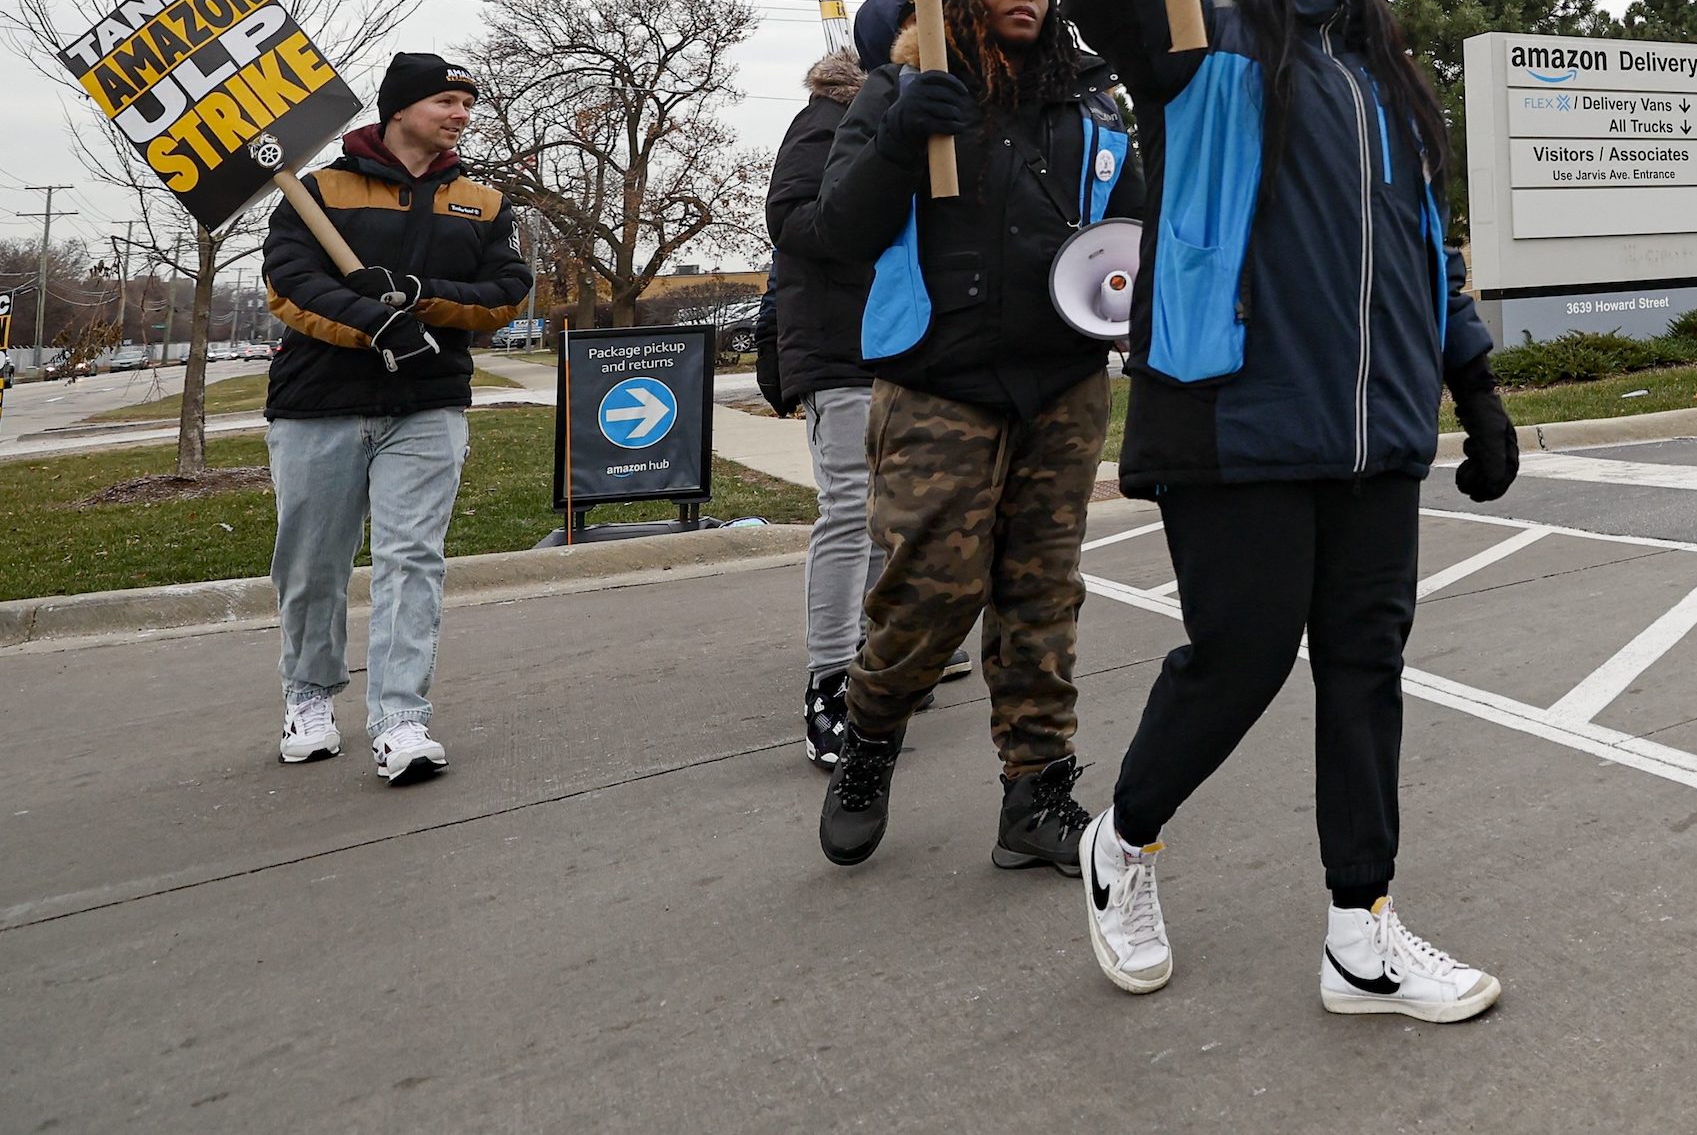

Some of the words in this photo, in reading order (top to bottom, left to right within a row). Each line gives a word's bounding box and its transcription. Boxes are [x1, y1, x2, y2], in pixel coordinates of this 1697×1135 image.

[1511, 46, 1607, 71] amazon
[1619, 51, 1697, 78] Delivery
[114, 4, 287, 144] ULP
[146, 30, 337, 193] STRIKE
[1524, 97, 1554, 109] FLEX
[1583, 96, 1637, 114] Delivery
[1641, 98, 1672, 112] Vans
[1609, 119, 1626, 133] All
[1630, 120, 1674, 133] Trucks
[1533, 146, 1594, 162] Visitors
[1609, 147, 1689, 162] Associates
[1552, 170, 1573, 181] Use
[1575, 170, 1606, 181] Jarvis
[1609, 169, 1631, 180] Ave.
[1633, 169, 1676, 180] Entrance
[1566, 301, 1592, 314] 3639
[1595, 298, 1636, 312] Howard
[1638, 296, 1670, 309] Street
[588, 346, 641, 359] Package
[643, 341, 686, 357] pickup
[601, 360, 626, 373] and
[628, 358, 675, 371] returns
[606, 463, 647, 475] amazon
[648, 459, 670, 471] hub
